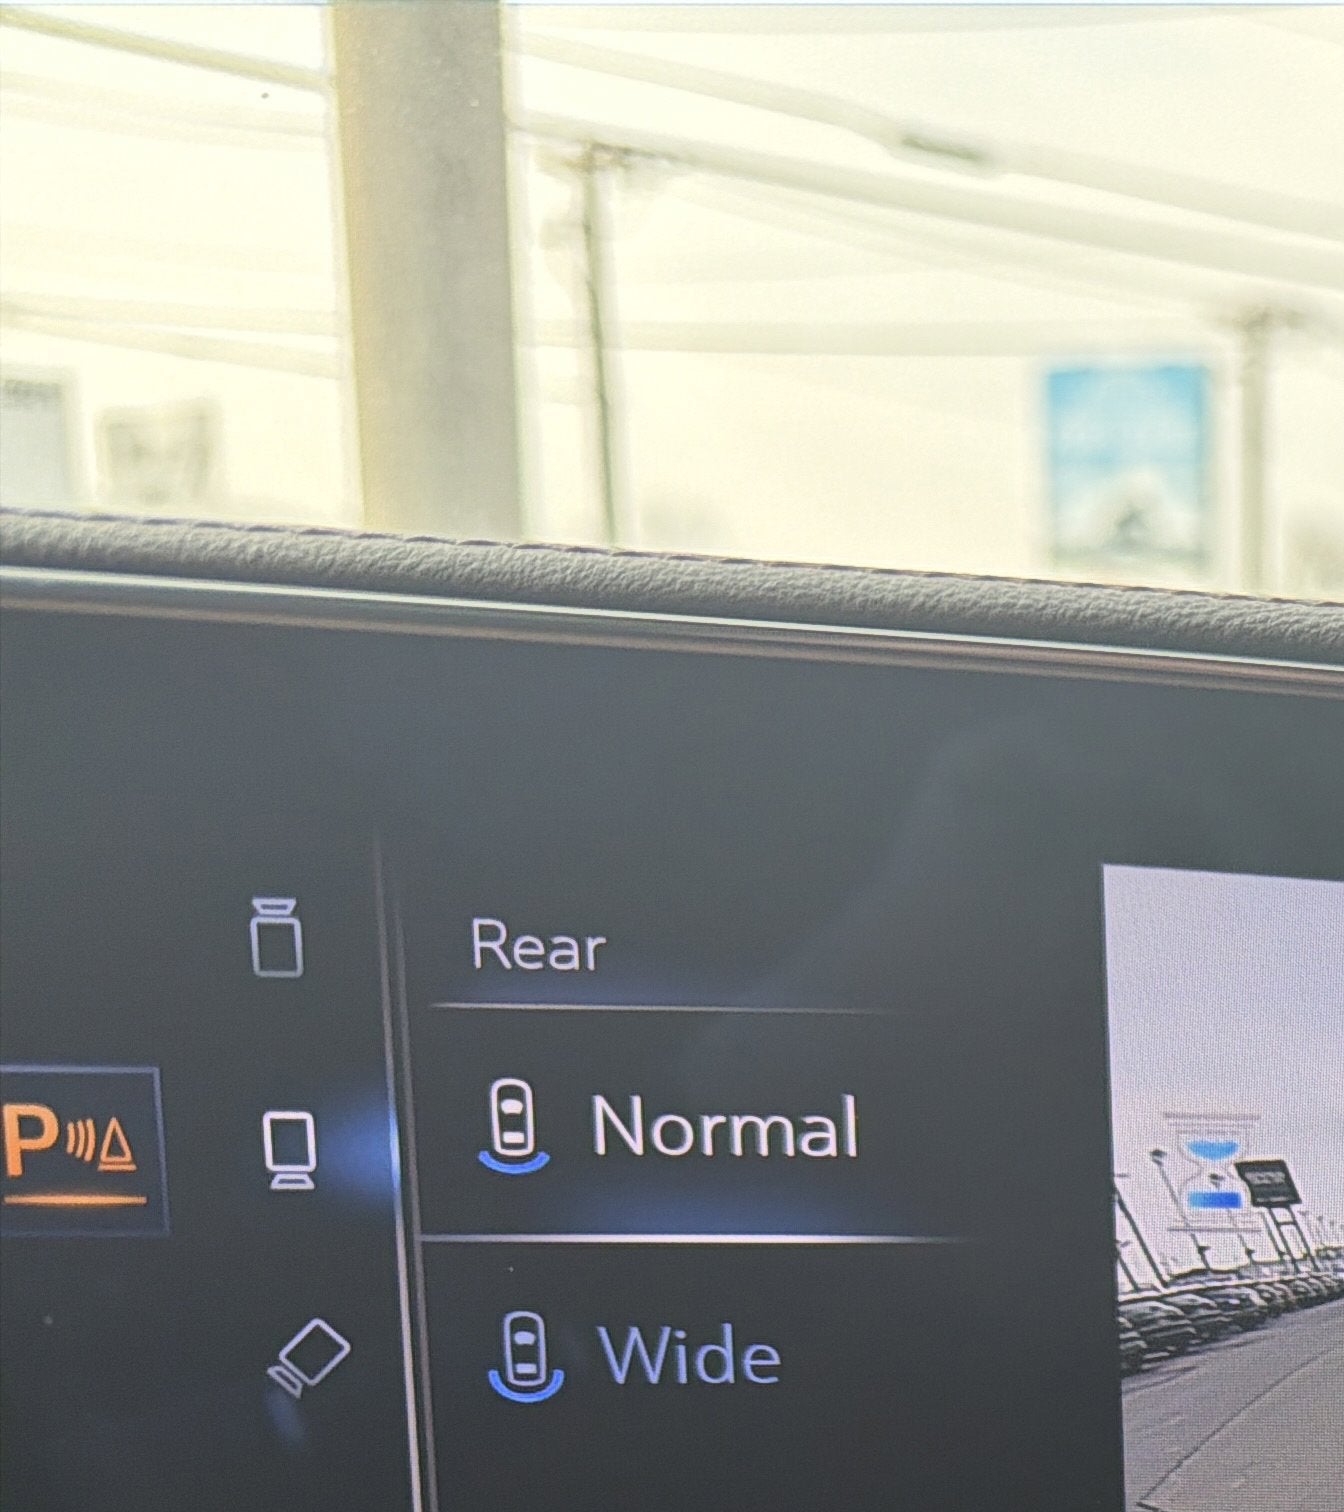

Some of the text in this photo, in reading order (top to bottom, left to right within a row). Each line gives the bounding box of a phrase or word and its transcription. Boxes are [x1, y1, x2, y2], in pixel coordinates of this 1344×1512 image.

[472, 918, 607, 973] Rear
[592, 1094, 860, 1159] Normal
[597, 1322, 783, 1387] Wide
